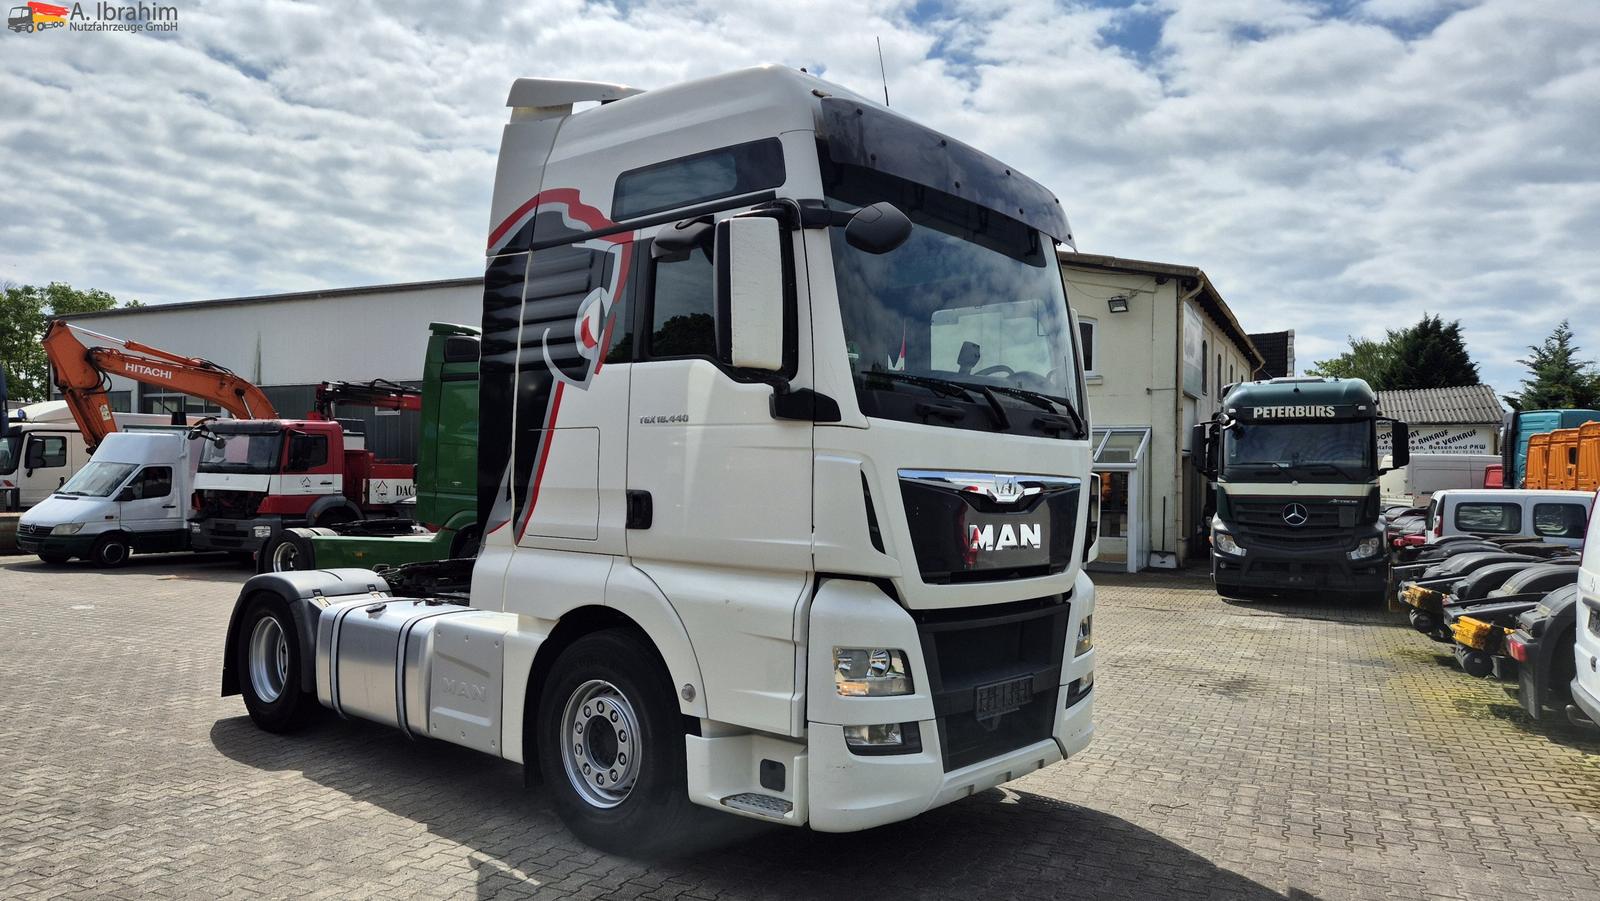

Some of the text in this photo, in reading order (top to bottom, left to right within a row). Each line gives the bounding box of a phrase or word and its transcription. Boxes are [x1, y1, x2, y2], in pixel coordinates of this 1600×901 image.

[125, 362, 172, 379] HITACHI
[1253, 405, 1336, 419] PETERBURS
[1418, 429, 1448, 445] ANKAUF
[1442, 429, 1477, 445] VERKAUF
[968, 523, 1041, 551] MAN
[441, 676, 487, 703] MAN
